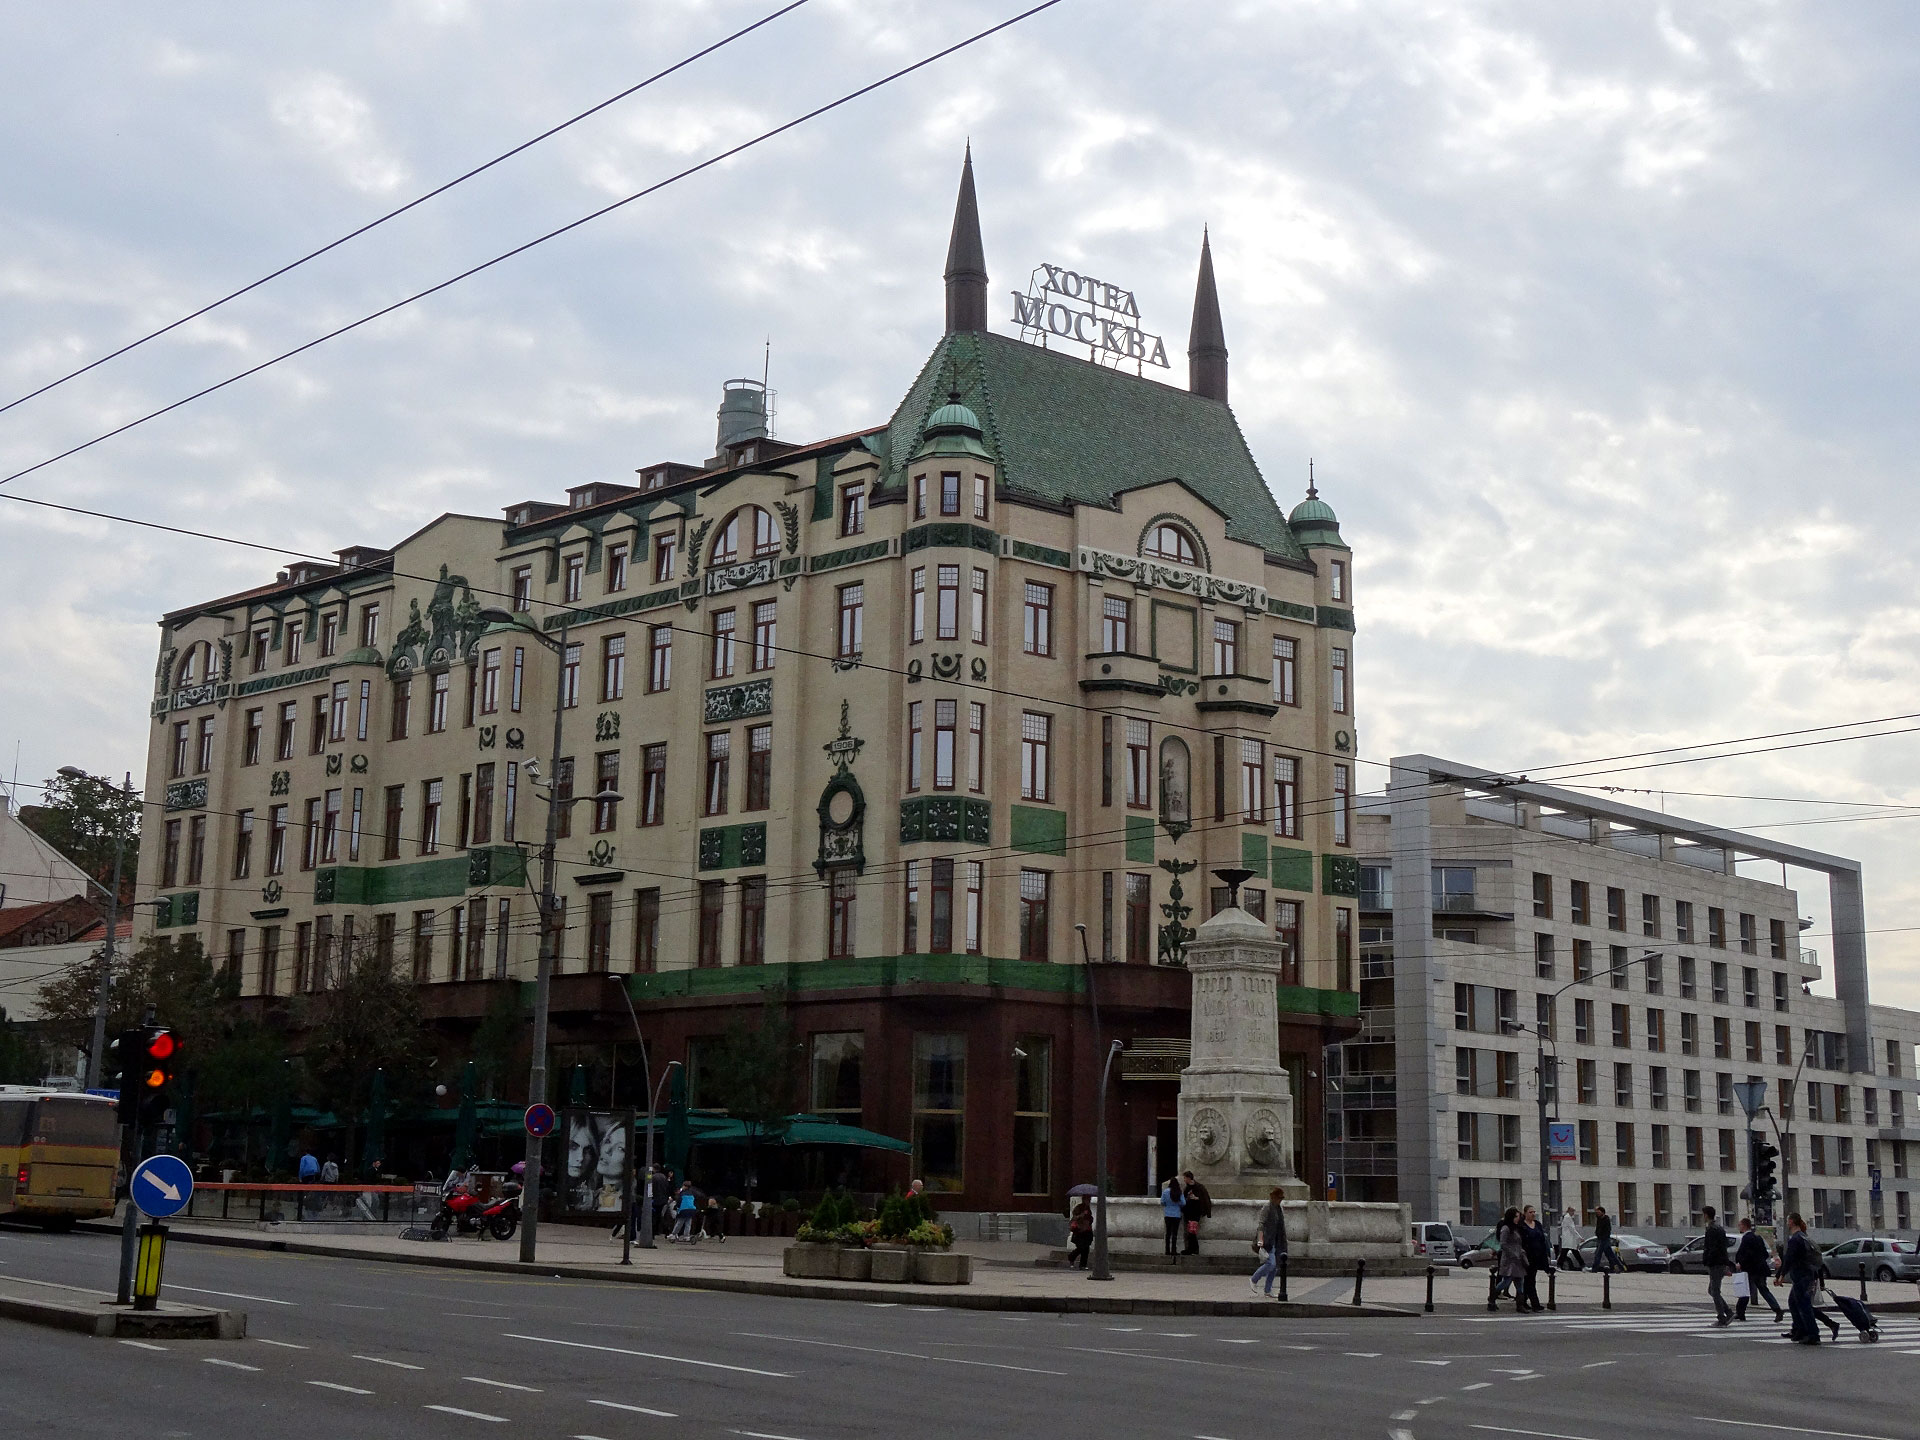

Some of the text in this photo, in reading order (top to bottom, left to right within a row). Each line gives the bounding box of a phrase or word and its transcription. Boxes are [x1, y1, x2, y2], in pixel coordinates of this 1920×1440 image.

[1040, 263, 1141, 318] ХОТЕЛ
[1011, 290, 1172, 369] МОСКВА
[834, 741, 853, 749] 1906
